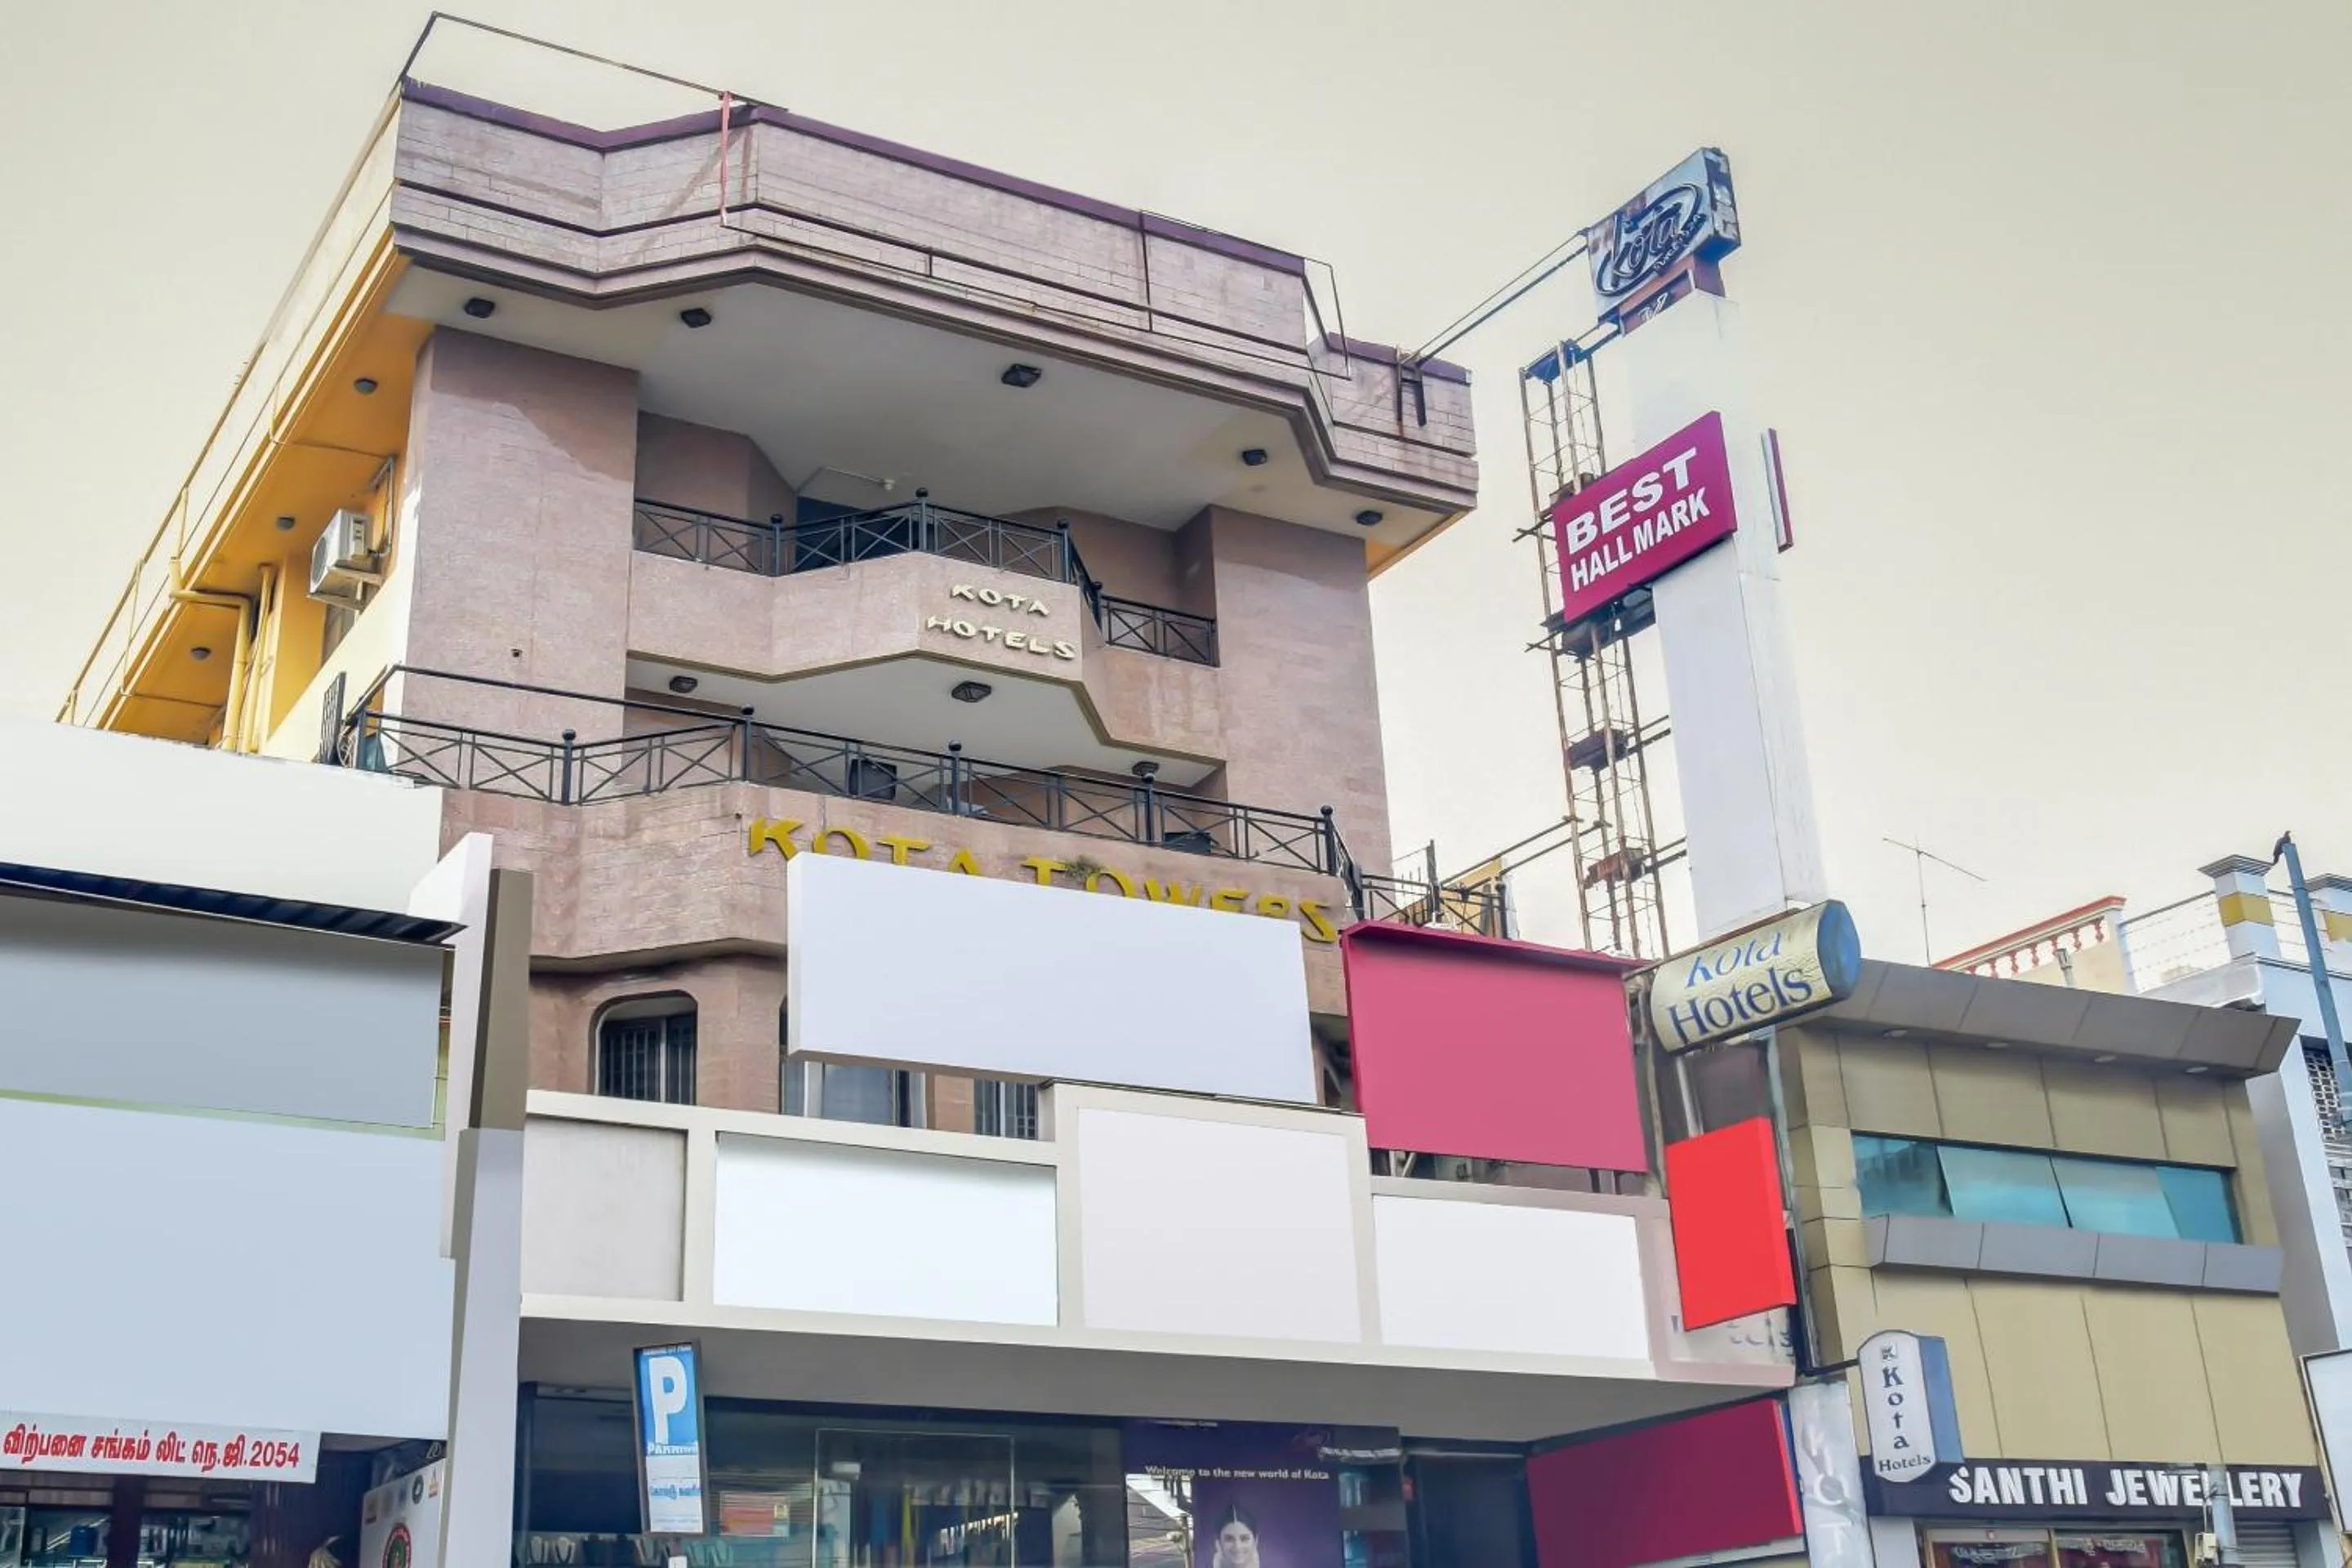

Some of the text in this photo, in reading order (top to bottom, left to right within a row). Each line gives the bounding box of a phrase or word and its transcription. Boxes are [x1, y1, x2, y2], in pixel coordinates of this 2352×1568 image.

[1566, 447, 1697, 555] BEST
[951, 584, 1050, 616] KOTA
[926, 616, 1076, 660] HOTELS
[1667, 966, 1812, 1045] Hotels
[90, 1428, 151, 1462] சங்கம்
[156, 1431, 186, 1463] லிட்
[1878, 1453, 1932, 1473] Hotels
[1144, 1464, 1196, 1479] Welcome
[1198, 1468, 1210, 1477] to
[1213, 1468, 1232, 1478] the
[1233, 1469, 1255, 1479] new
[1258, 1468, 1289, 1480] world
[1290, 1469, 1302, 1480] of
[1949, 1466, 2088, 1506] SANTHI
